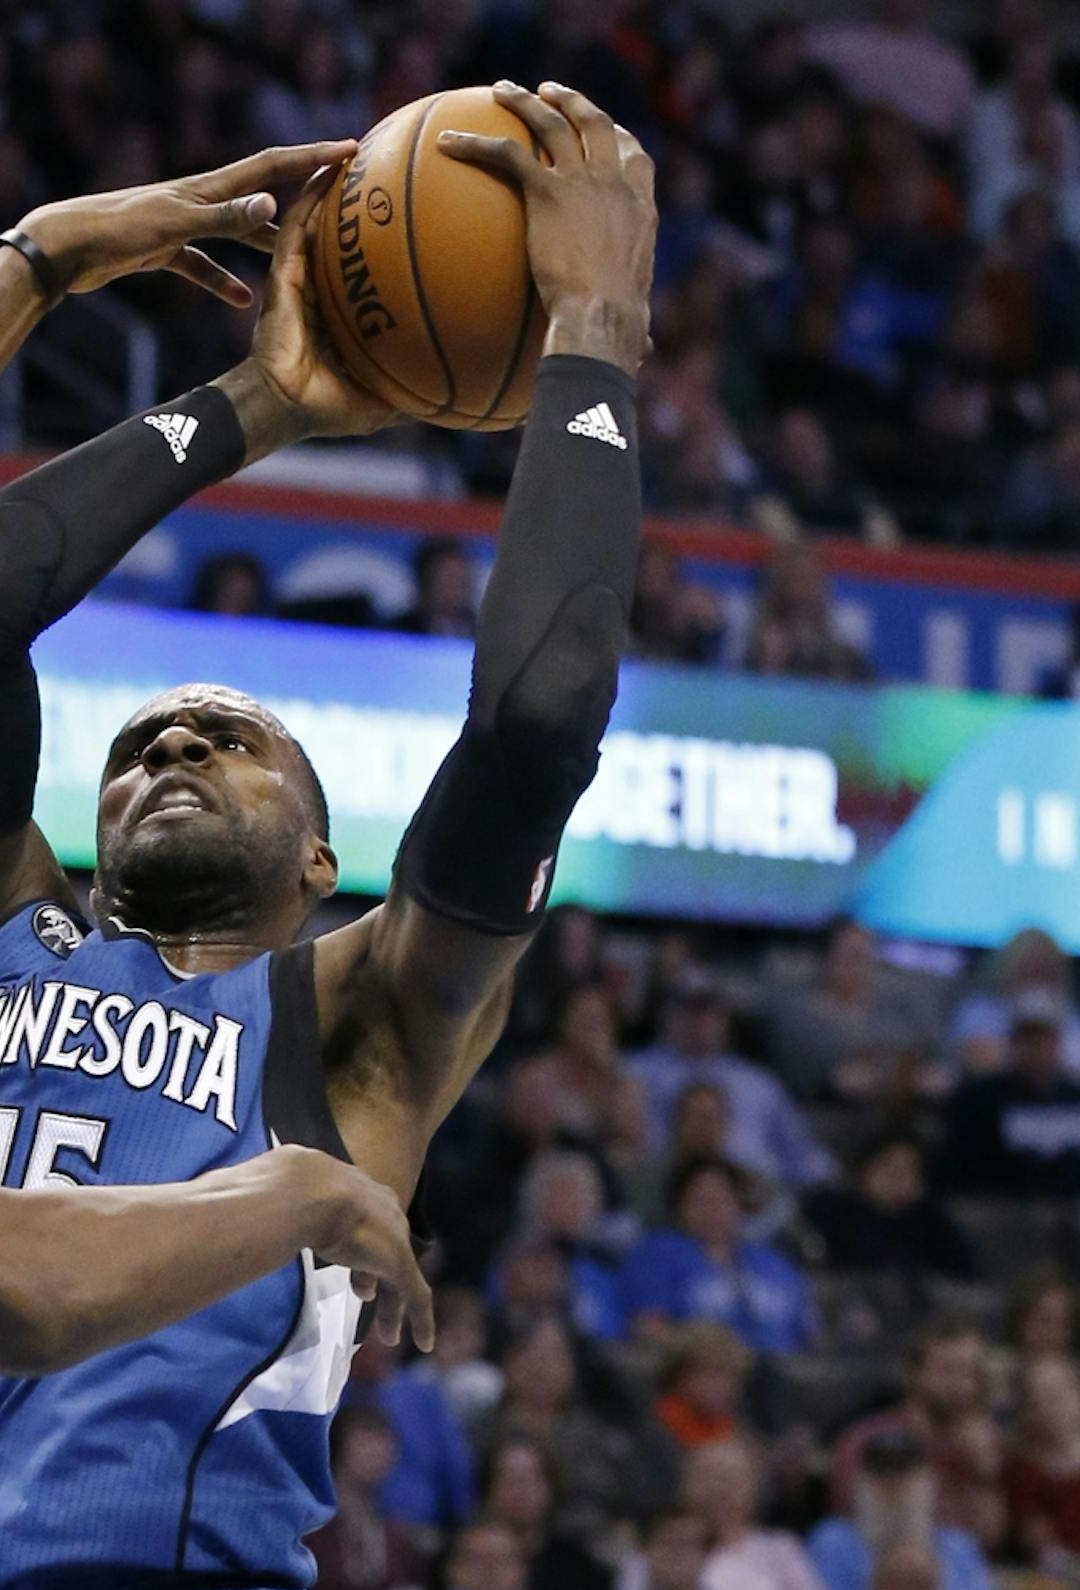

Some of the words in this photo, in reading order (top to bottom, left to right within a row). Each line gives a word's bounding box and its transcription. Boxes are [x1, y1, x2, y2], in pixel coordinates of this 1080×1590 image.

[338, 150, 398, 338] ALDING
[142, 414, 187, 464] adidas
[566, 419, 628, 450] adidas
